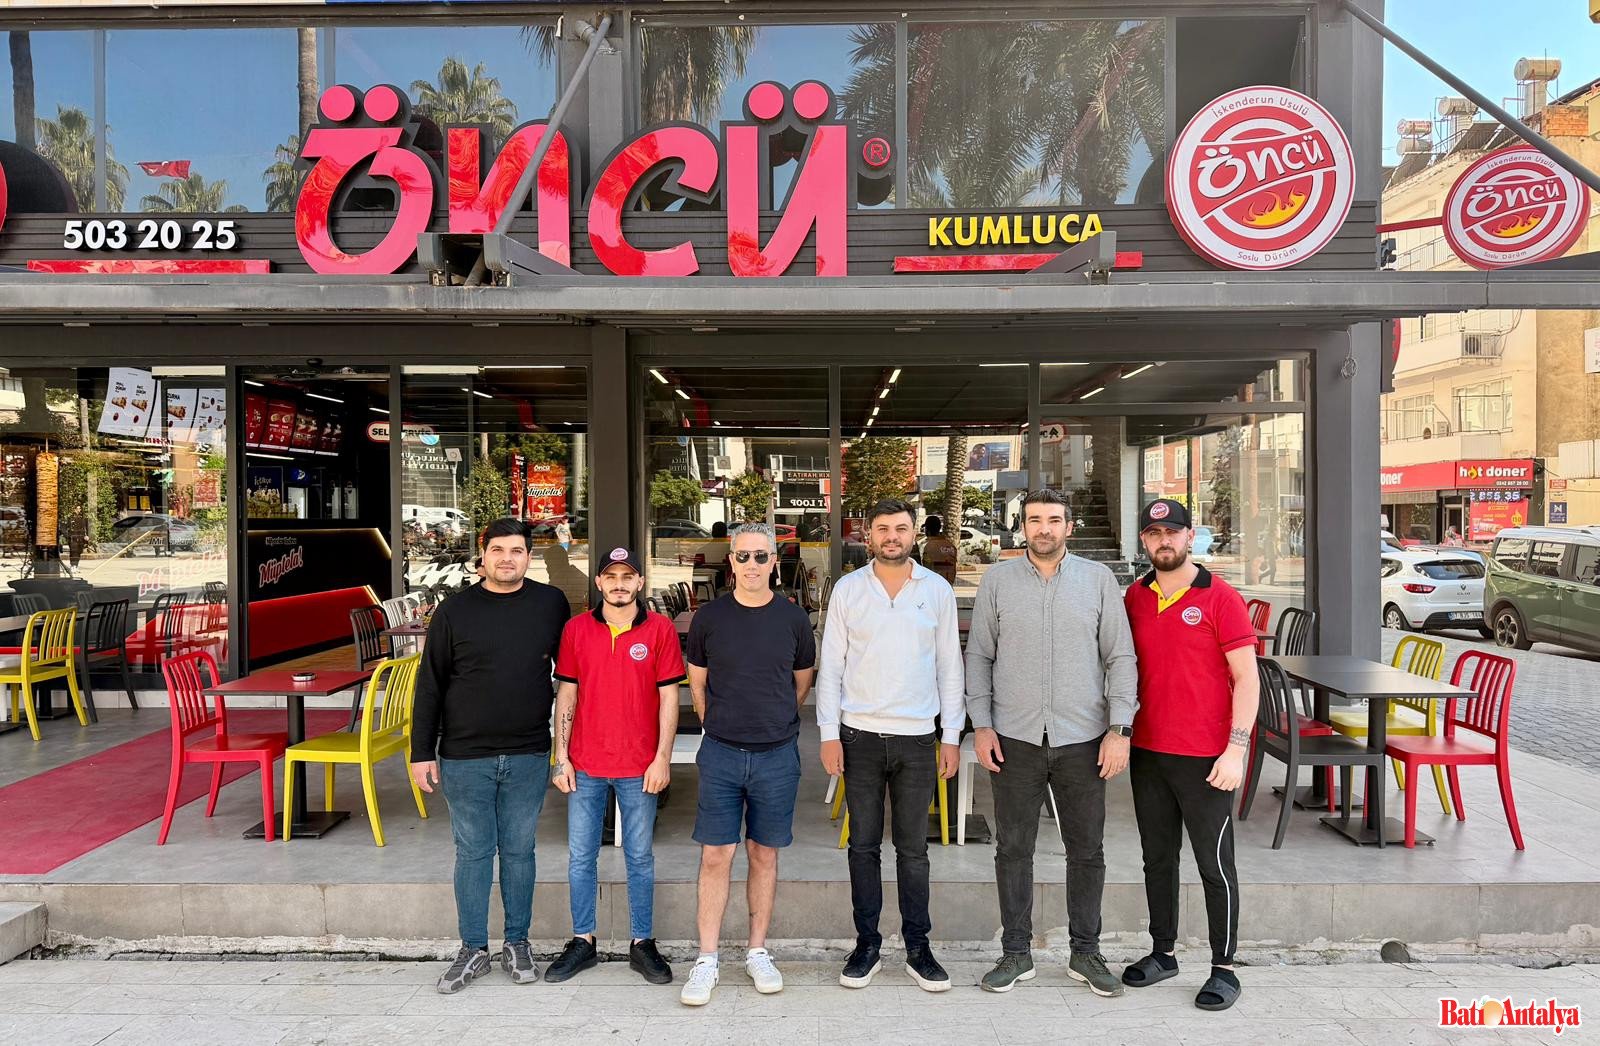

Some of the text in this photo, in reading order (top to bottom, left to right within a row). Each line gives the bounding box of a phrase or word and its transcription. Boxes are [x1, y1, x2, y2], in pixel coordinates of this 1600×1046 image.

[1211, 96, 1310, 118] İskenderun Usulü
[63, 219, 236, 250] 503 20 25
[928, 213, 1104, 247] KUMLUCA
[1237, 247, 1298, 262] Soslu Dürüm
[258, 546, 304, 588] Müptela!
